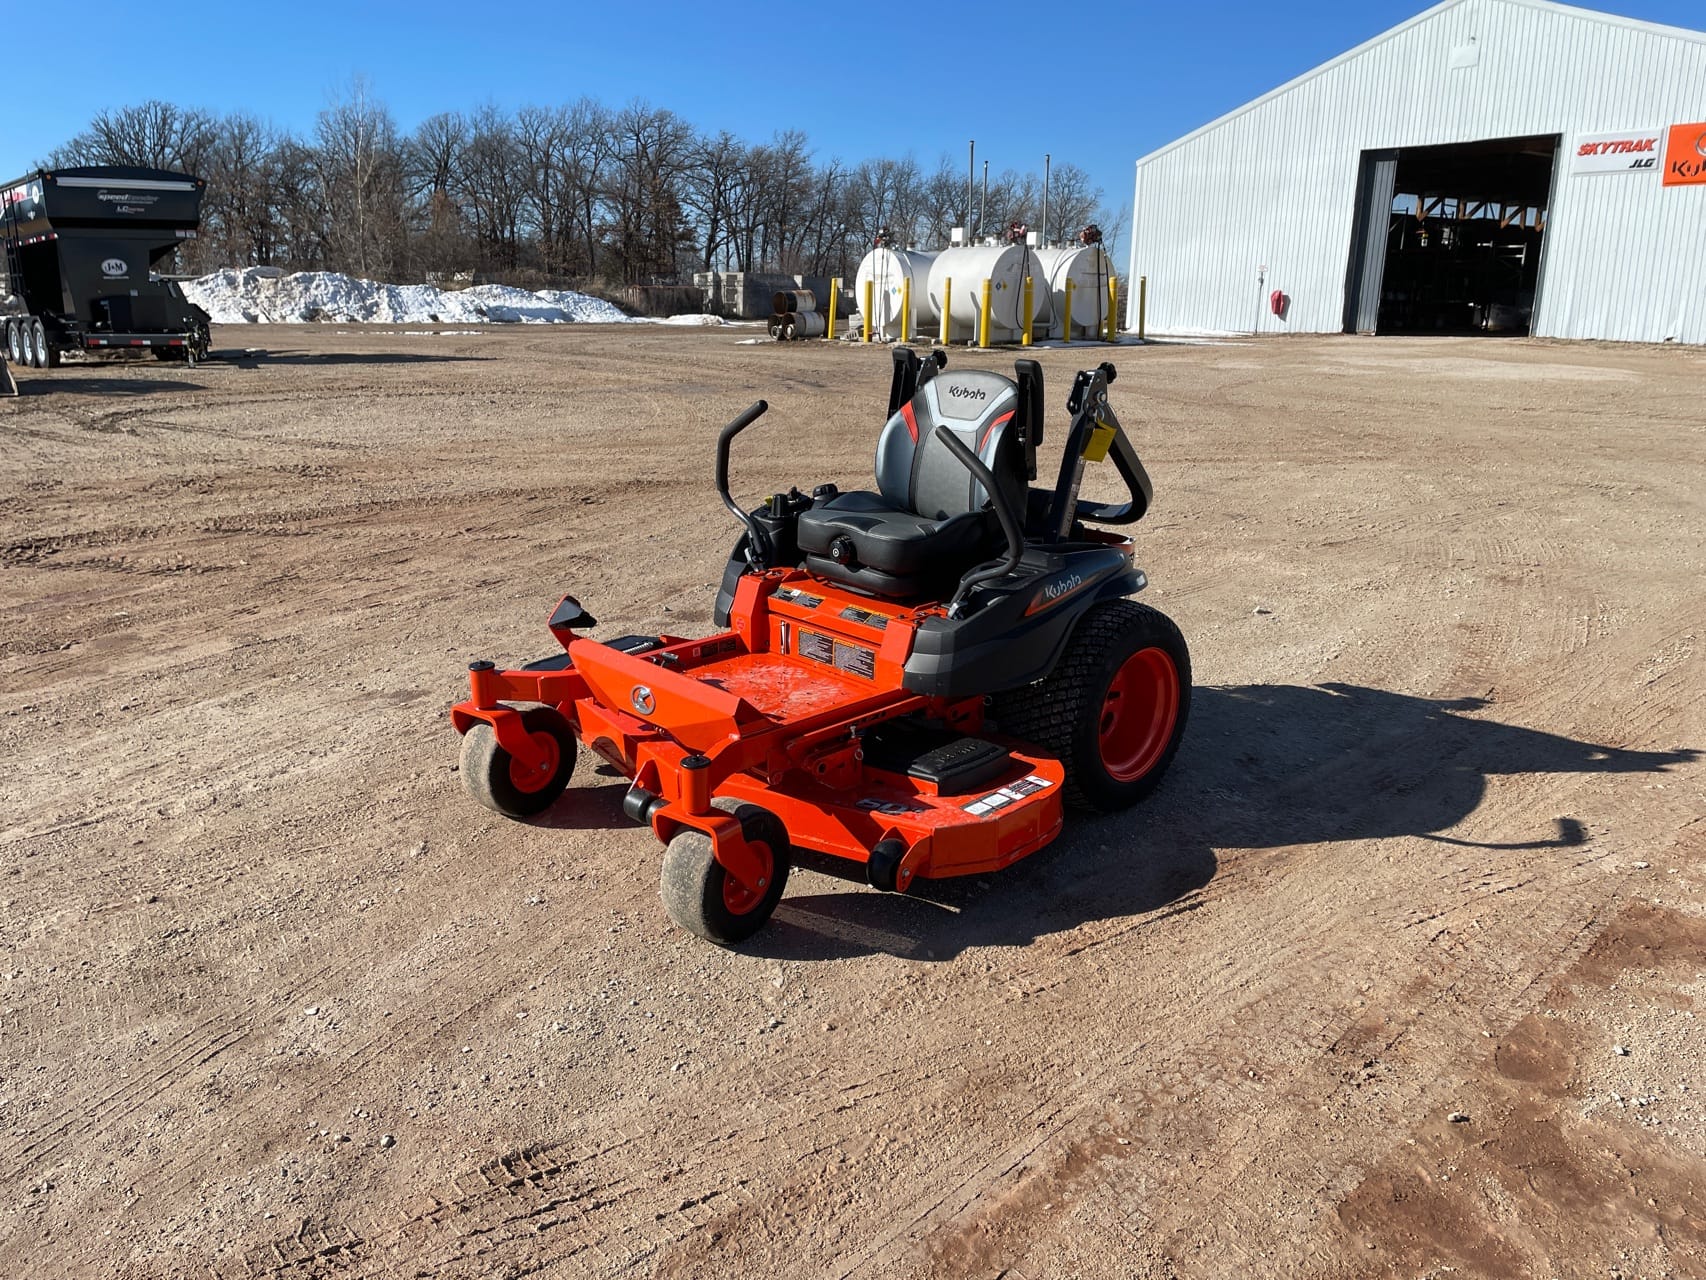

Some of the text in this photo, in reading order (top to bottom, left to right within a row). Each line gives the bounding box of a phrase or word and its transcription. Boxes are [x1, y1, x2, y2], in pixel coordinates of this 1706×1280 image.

[1577, 138, 1658, 156] SKYTRAK
[1629, 158, 1656, 168] JLG
[948, 385, 987, 400] Kubota
[1044, 574, 1082, 599] Kubota
